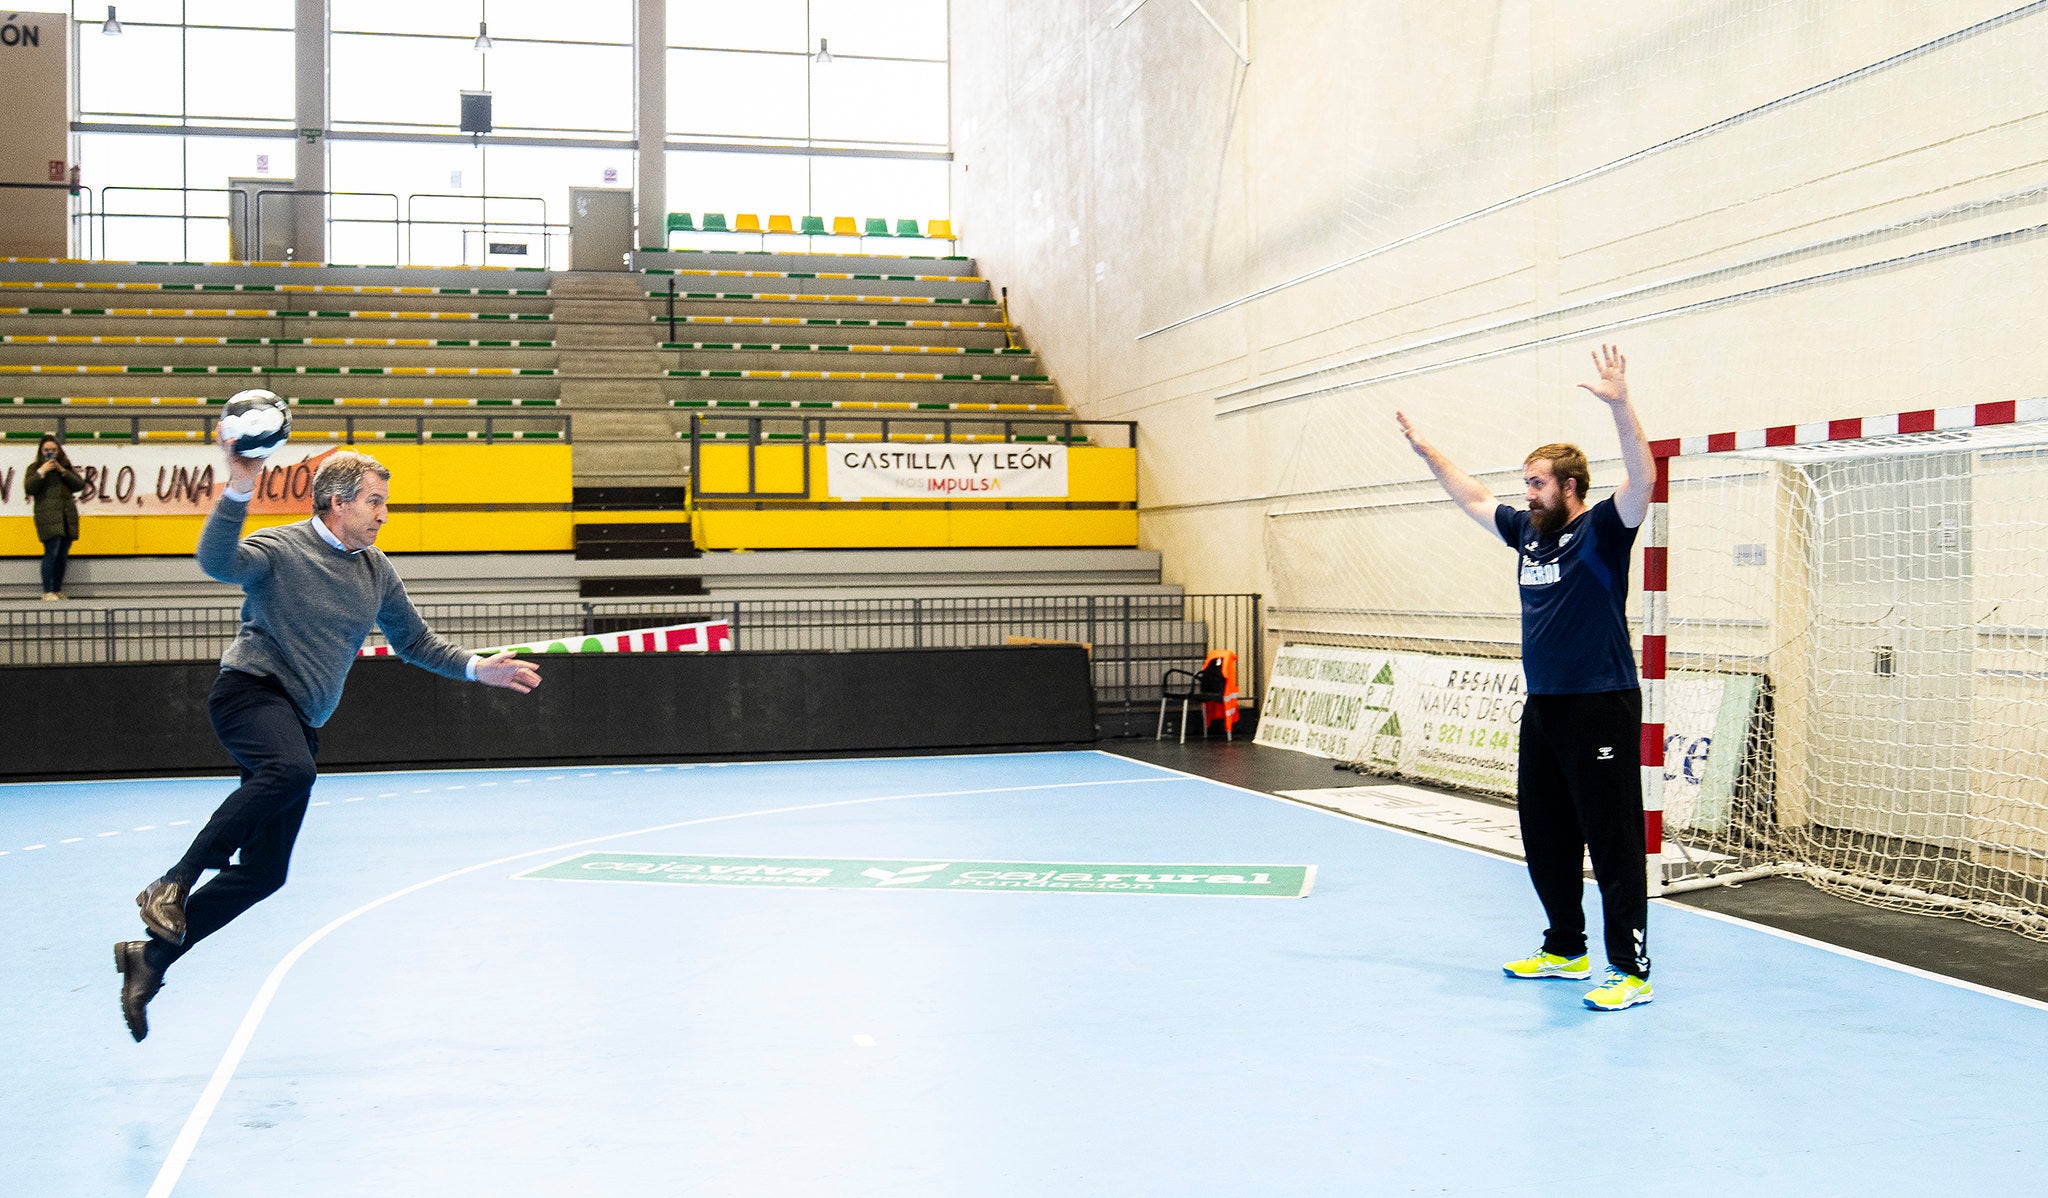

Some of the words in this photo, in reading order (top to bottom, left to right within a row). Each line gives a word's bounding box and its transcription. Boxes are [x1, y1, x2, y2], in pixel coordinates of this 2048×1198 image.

[844, 452, 955, 470] CASTILLA
[969, 453, 983, 473] Y
[994, 448, 1052, 469] LEÓN
[157, 464, 215, 505] UNA
[895, 477, 924, 488] NOS
[927, 477, 1001, 494] IMPULSA
[1447, 670, 1528, 697] RESINA
[1418, 690, 1472, 719] NAVAS
[1477, 697, 1502, 722] DE
[1509, 699, 1524, 724] O
[1439, 723, 1463, 745] 921
[1469, 727, 1486, 747] 12
[1490, 730, 1510, 750] 44
[1408, 810, 1523, 841] ERE
[582, 861, 833, 877] cajaviva
[959, 870, 1272, 885] cajarural
